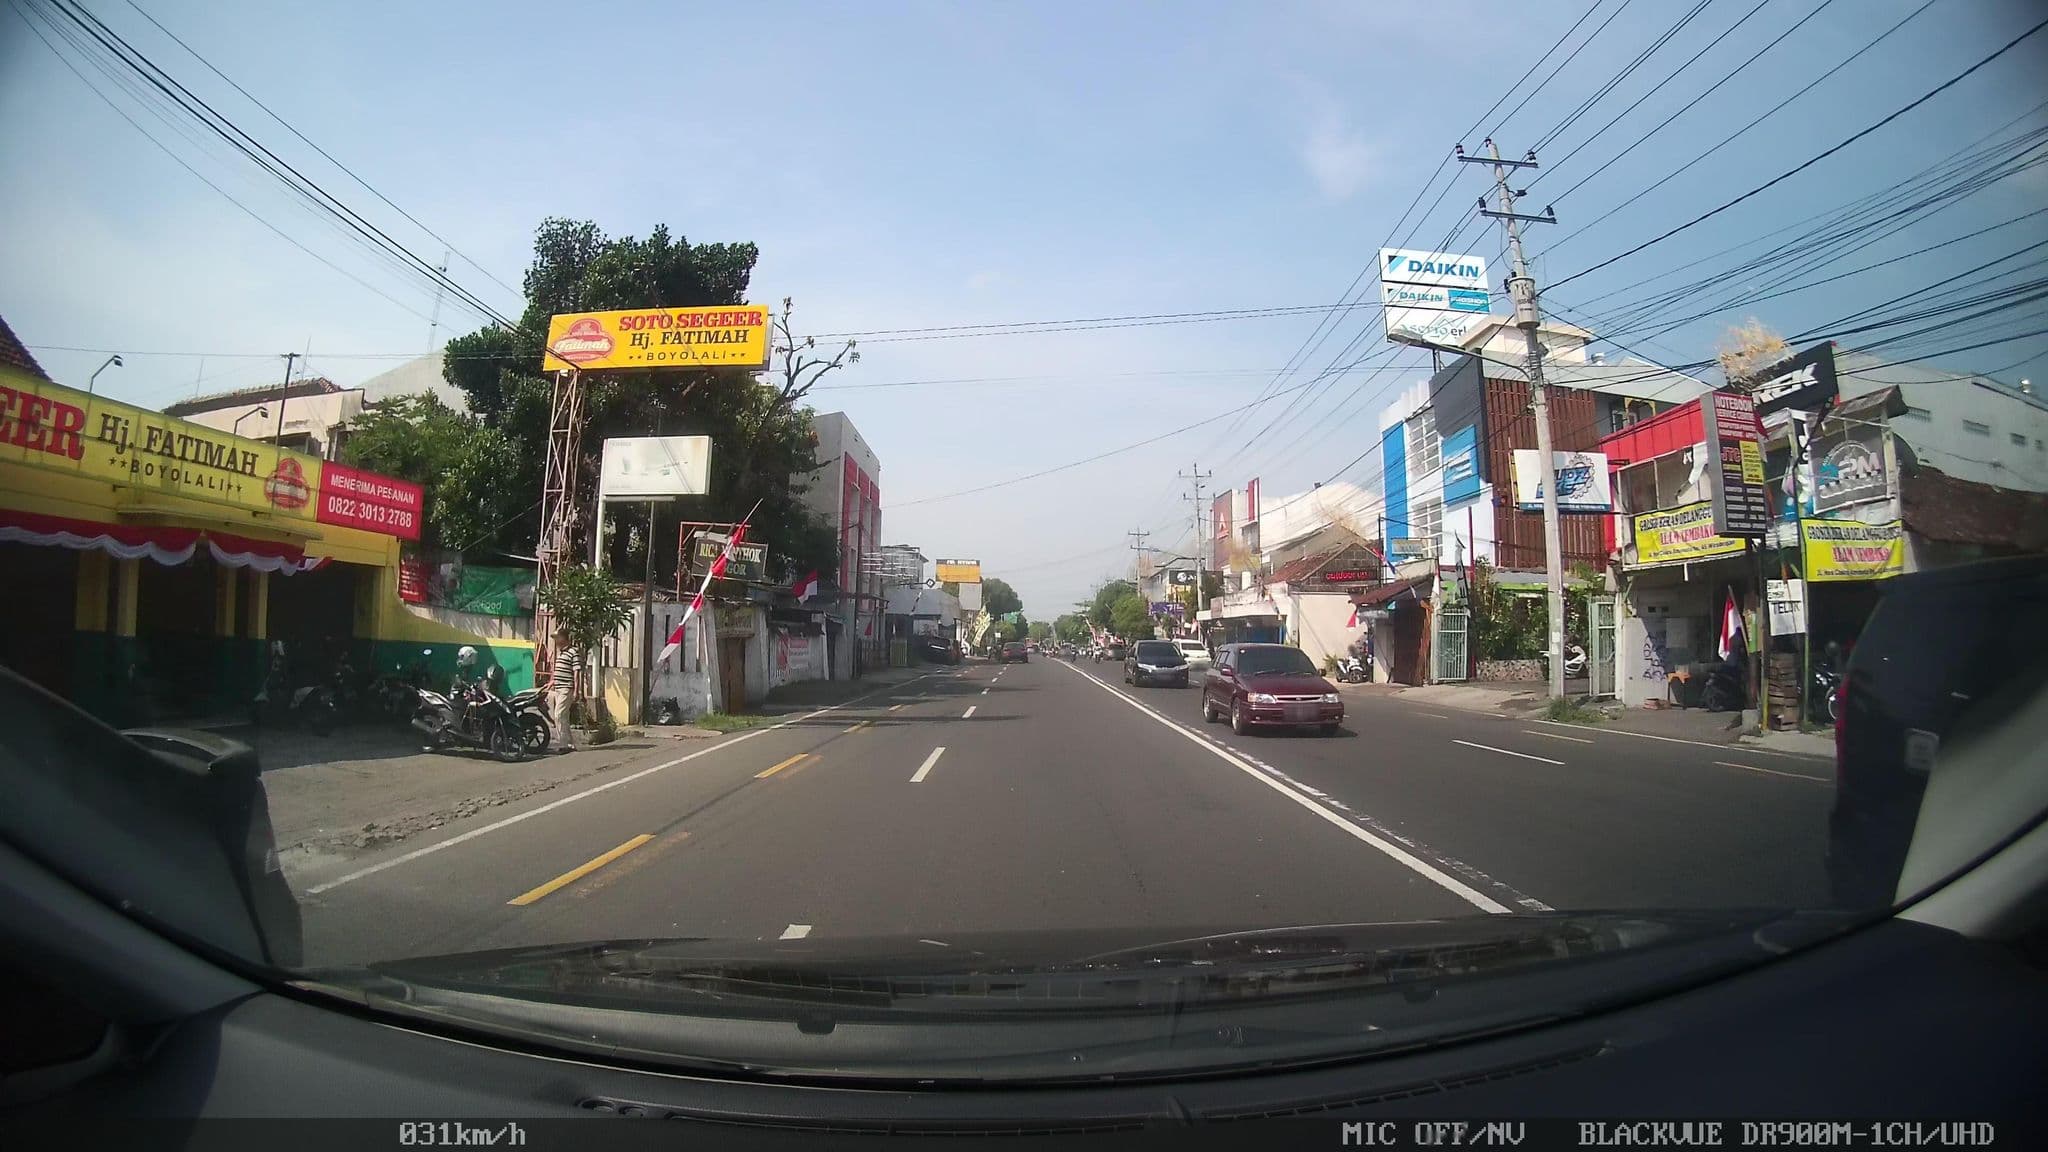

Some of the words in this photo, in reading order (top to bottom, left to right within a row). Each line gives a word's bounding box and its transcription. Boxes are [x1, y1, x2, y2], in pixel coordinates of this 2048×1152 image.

[1408, 260, 1479, 277] DAIKIN
[1400, 291, 1443, 302] DAIKIN
[619, 315, 673, 331] SOTO
[675, 311, 763, 328] SEGEER
[630, 333, 654, 349] Hj.
[661, 329, 749, 346] FATIMAH
[646, 350, 727, 361] BOYOLALI
[98, 412, 135, 455] Hj.
[143, 425, 259, 477] FATIMAH
[130, 458, 224, 491] BOYOLALI
[331, 474, 376, 495] MENERIMA
[377, 486, 414, 504] PESANAN
[328, 496, 356, 517] 0822
[358, 502, 385, 522] 3013
[387, 508, 412, 528] 2788
